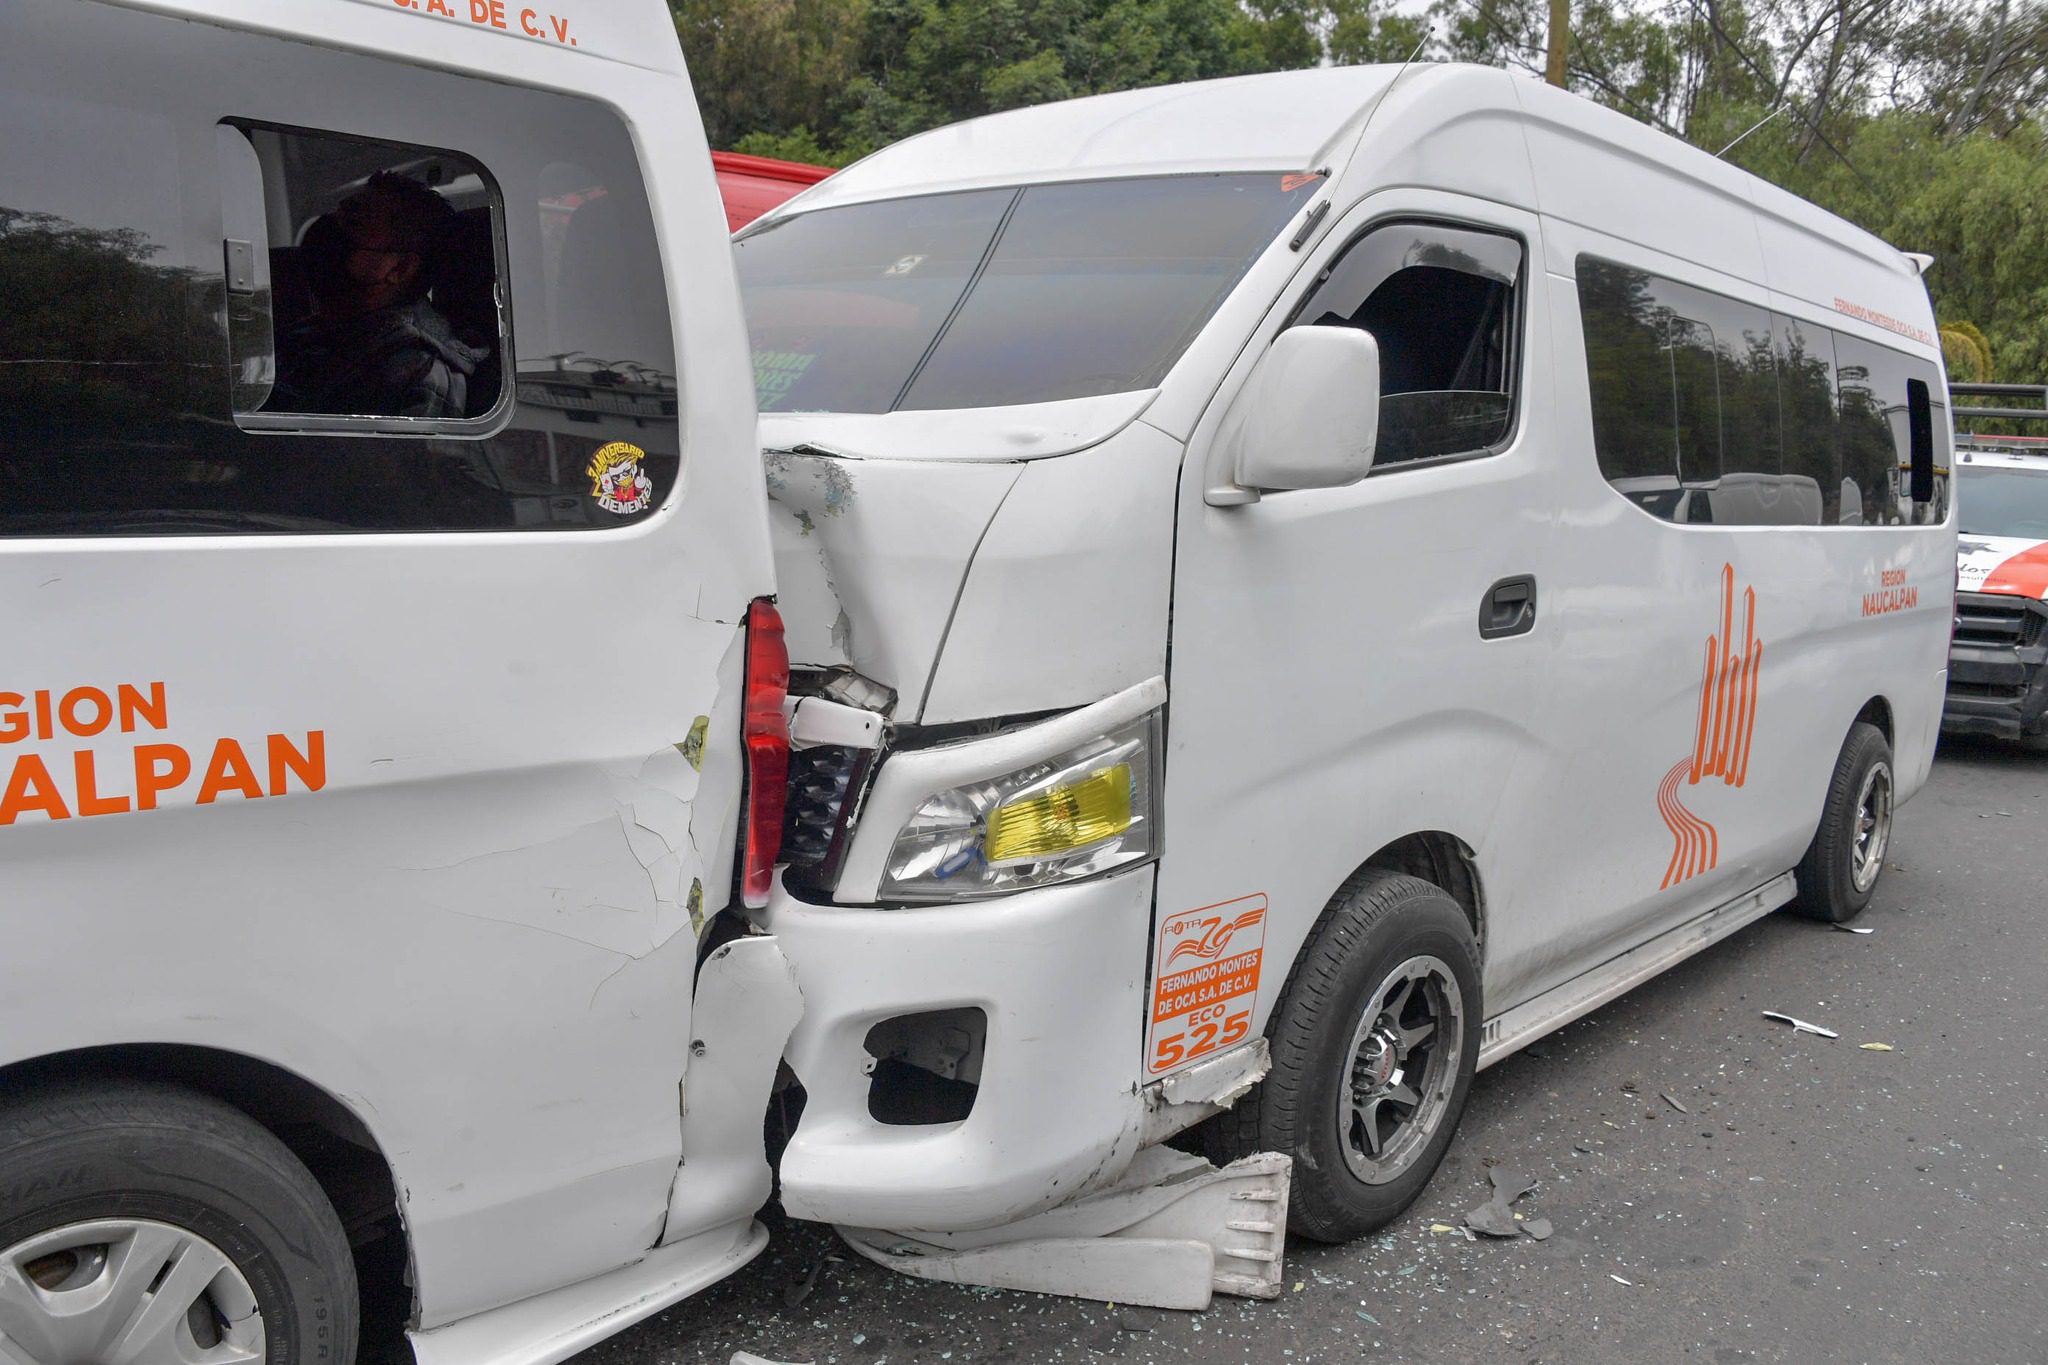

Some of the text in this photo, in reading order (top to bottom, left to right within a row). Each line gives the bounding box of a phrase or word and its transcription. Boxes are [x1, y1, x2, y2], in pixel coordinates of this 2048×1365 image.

[470, 0, 507, 29] DE
[520, 8, 577, 46] C.V.
[1881, 568, 1906, 587] REGION
[1863, 586, 1918, 617] NAUCALPAN
[0, 681, 168, 744] GION
[0, 730, 327, 826] ALPAN
[1158, 974, 1252, 1016] DE OCA S.A. DE C.V.
[1160, 952, 1258, 995] FERNANDO MONTES
[1188, 1004, 1226, 1027] ECO
[1153, 1010, 1250, 1069] 525
